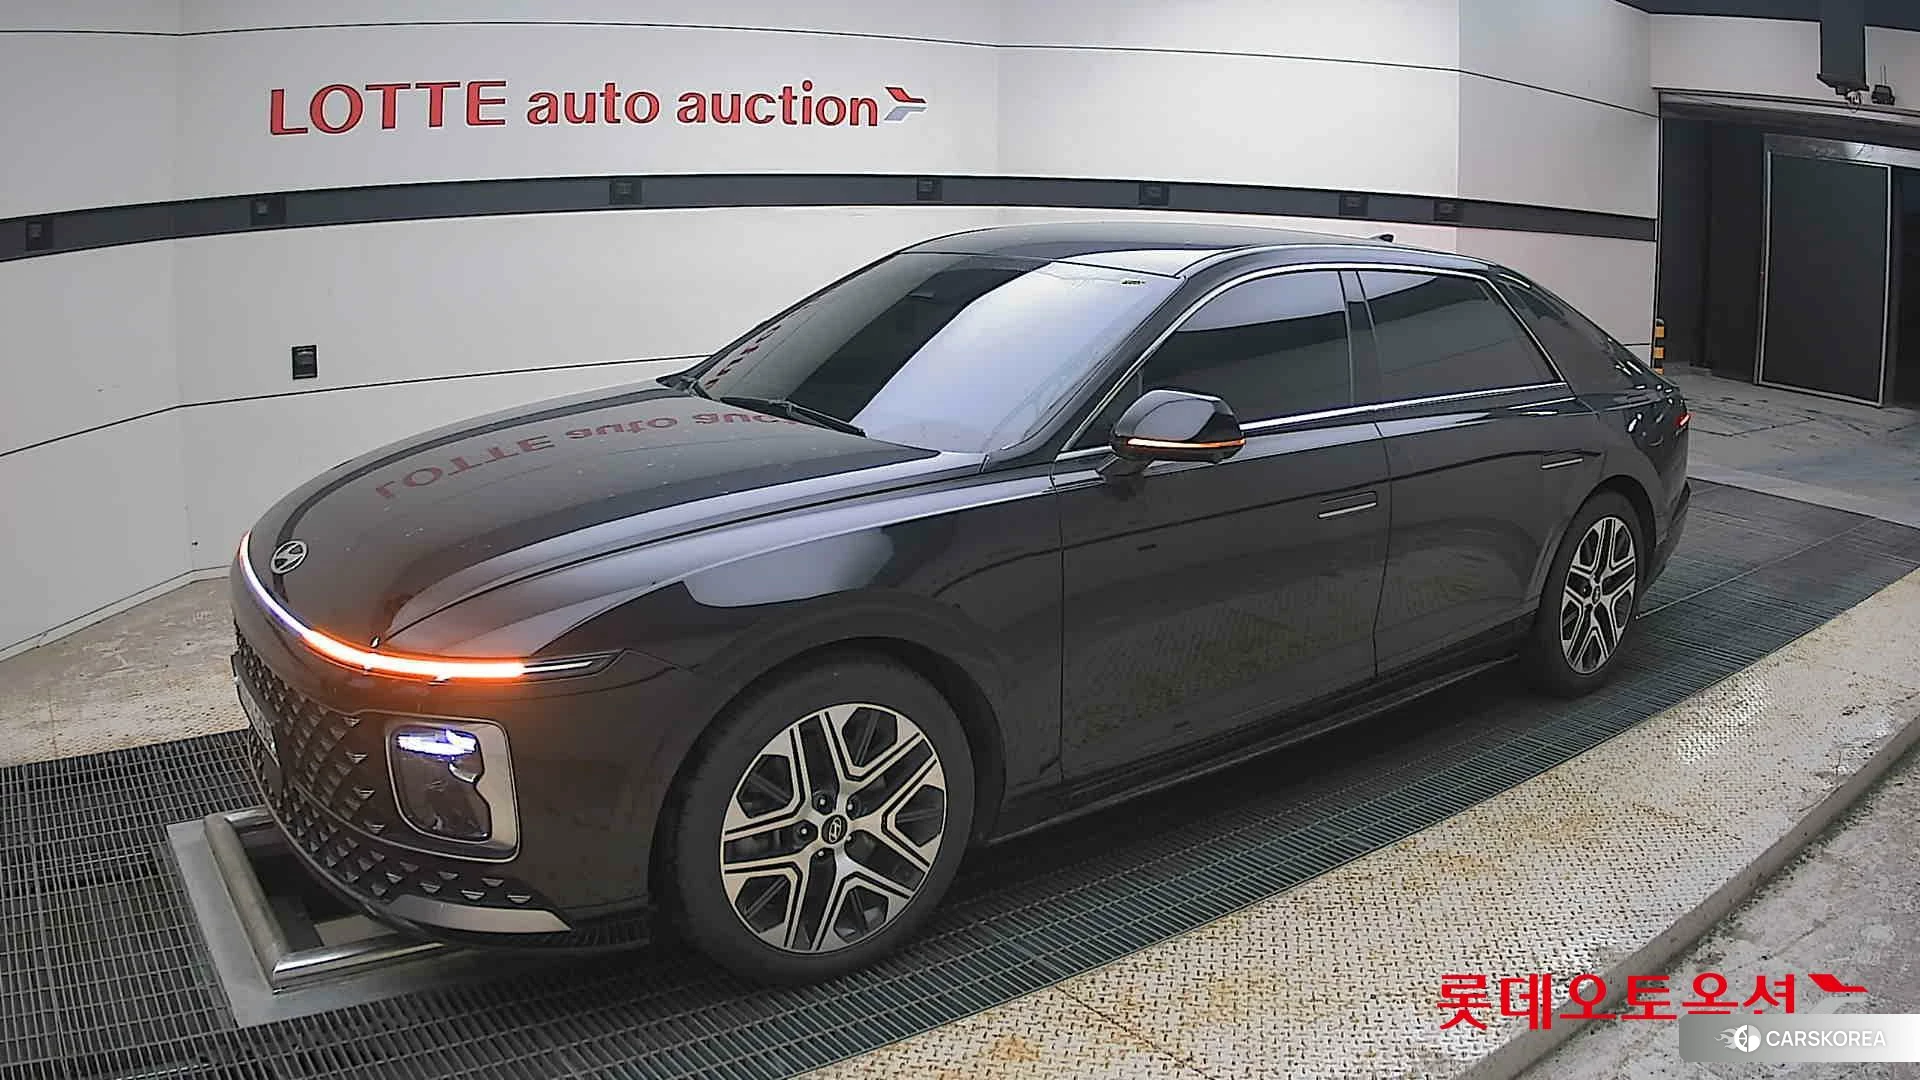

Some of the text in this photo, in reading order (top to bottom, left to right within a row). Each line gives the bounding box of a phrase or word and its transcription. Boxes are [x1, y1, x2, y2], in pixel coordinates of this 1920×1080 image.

[269, 80, 879, 136] LOTTE auto auction
